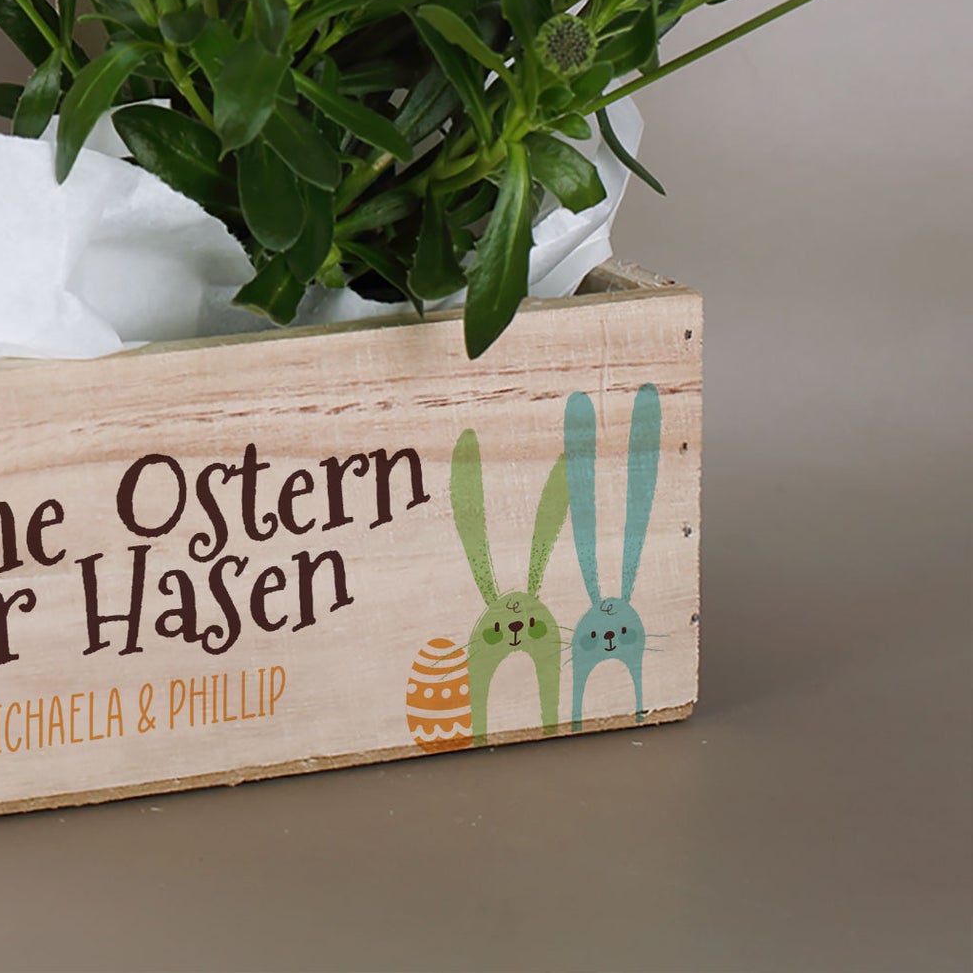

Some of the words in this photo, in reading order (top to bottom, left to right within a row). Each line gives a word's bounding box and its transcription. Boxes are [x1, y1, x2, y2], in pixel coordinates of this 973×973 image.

[116, 442, 431, 563] Ostern
[74, 544, 355, 656] Hasen
[137, 682, 156, 735] &
[169, 665, 287, 731] PHILLIP
